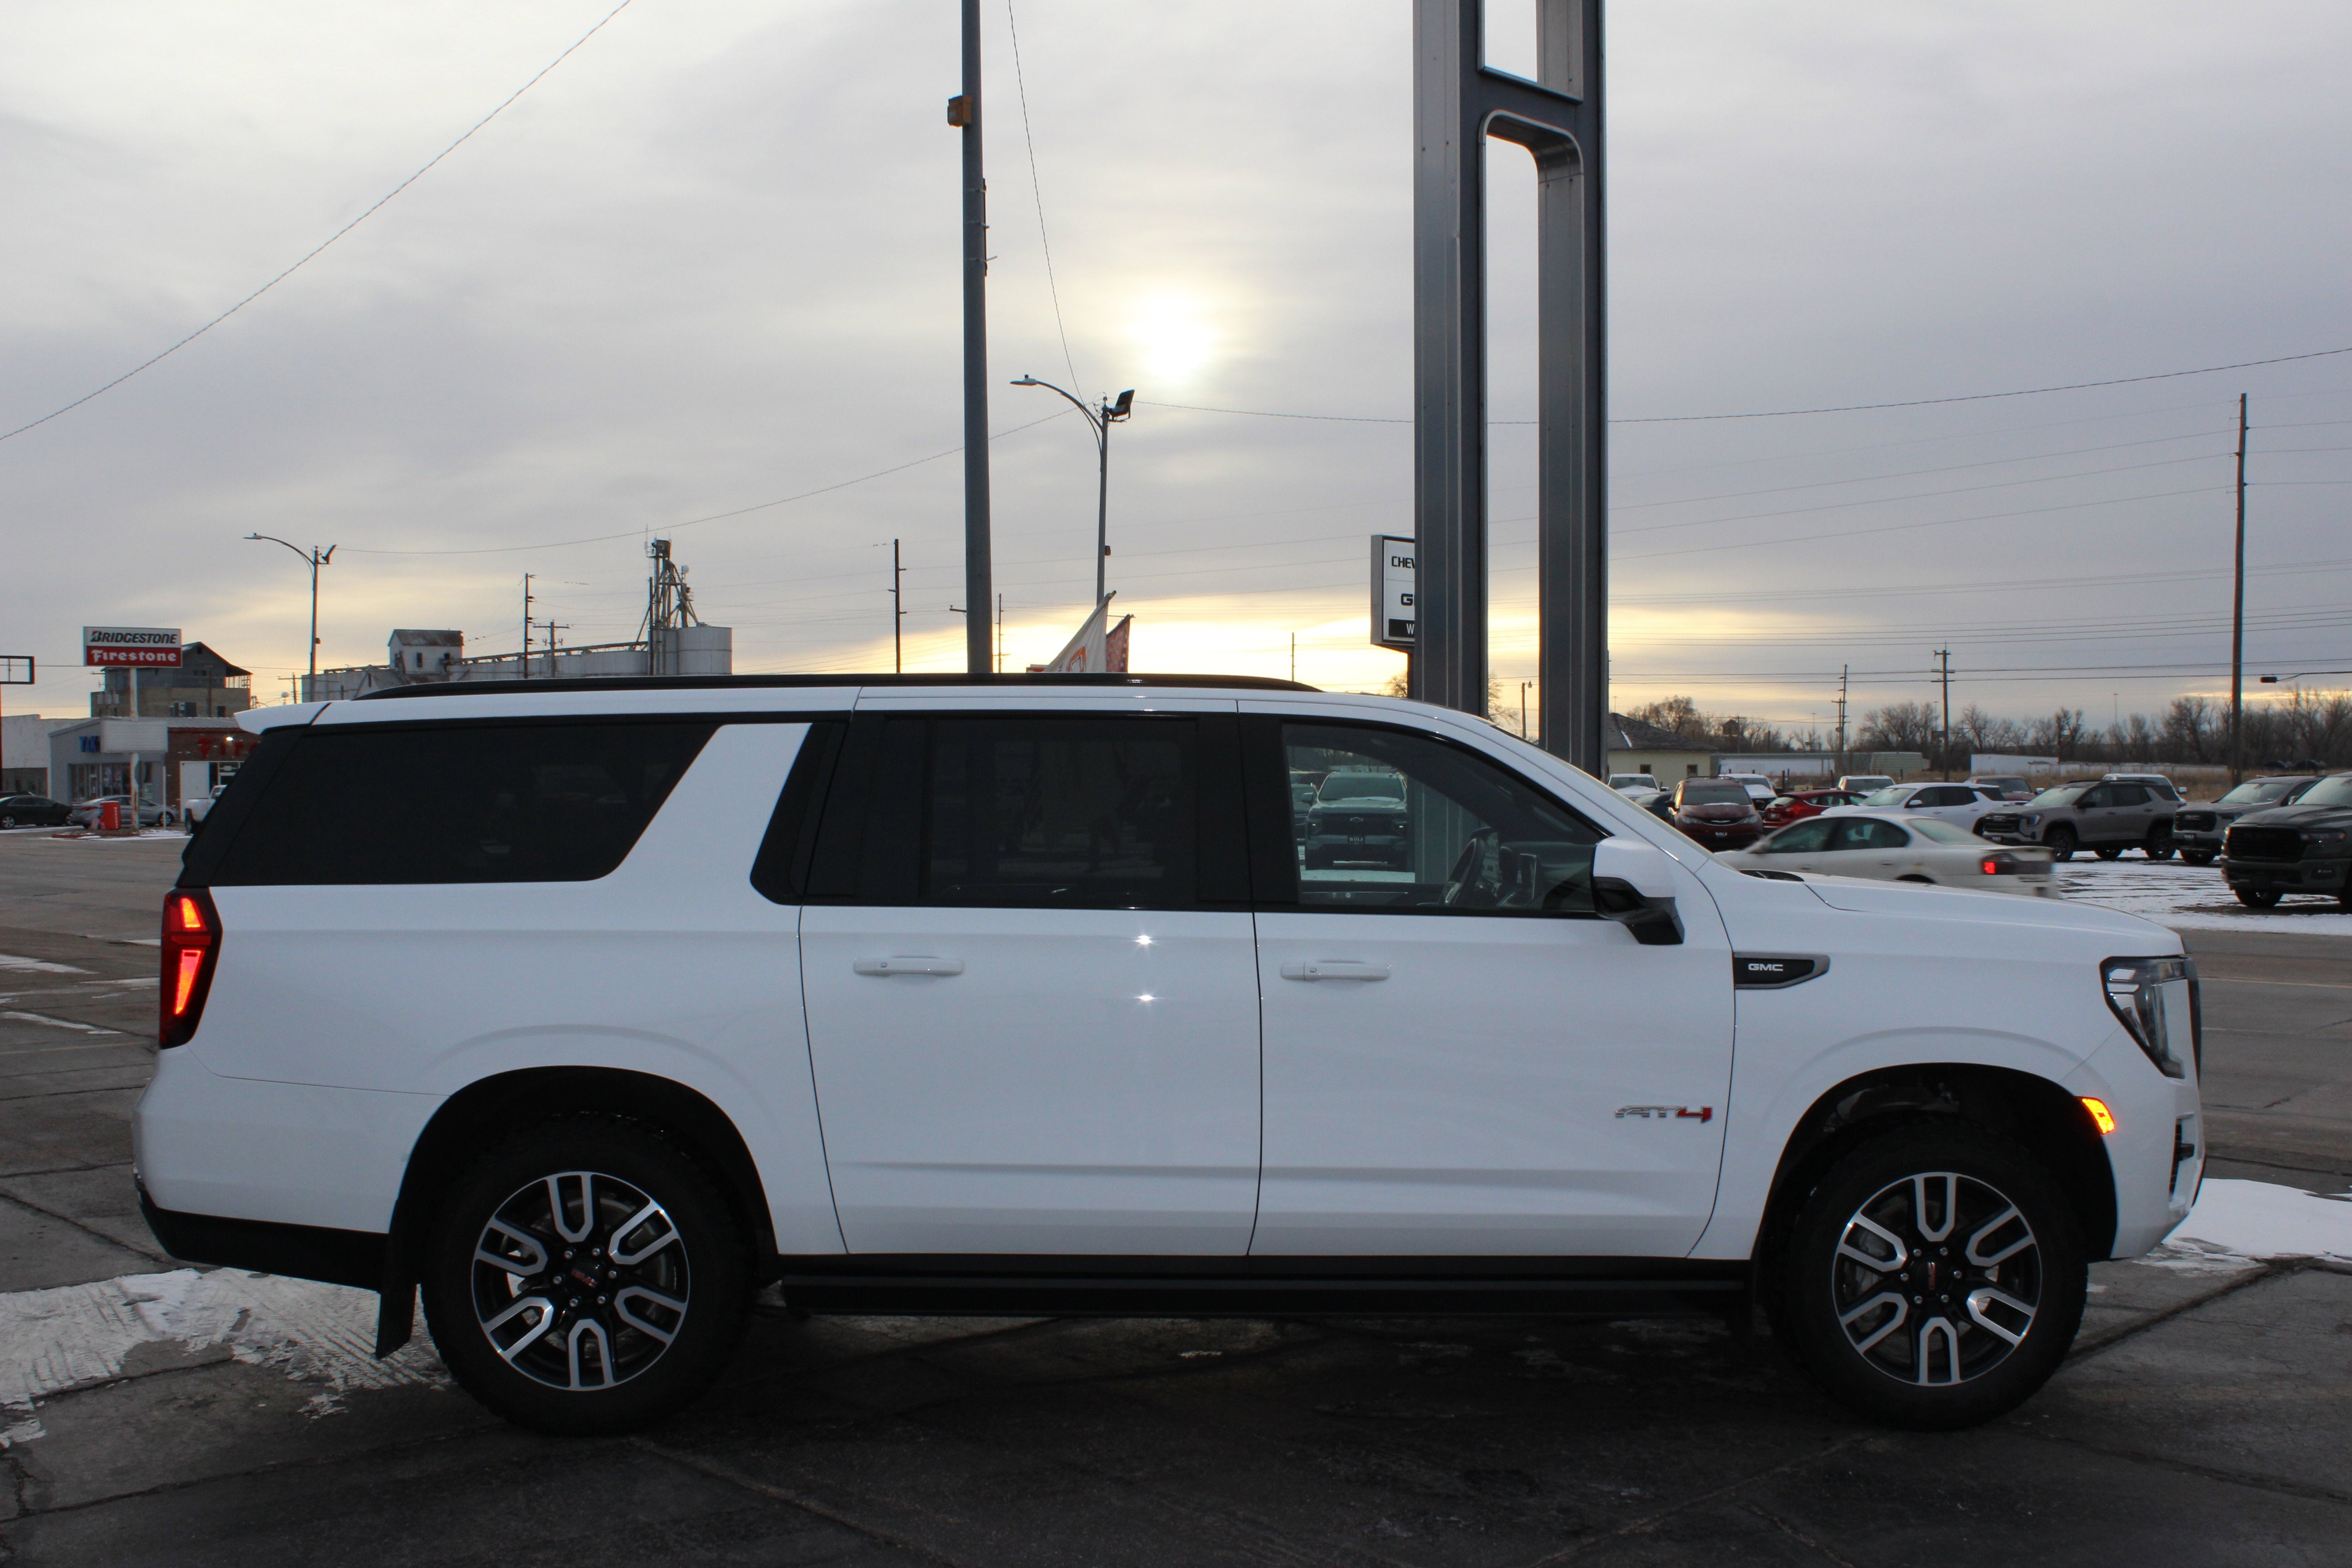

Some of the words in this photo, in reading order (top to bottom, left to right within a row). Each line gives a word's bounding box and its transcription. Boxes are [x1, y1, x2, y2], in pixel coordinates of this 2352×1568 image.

[1401, 593, 1415, 606] G
[91, 631, 177, 644] BRIDGESTONE
[92, 650, 176, 663] Firestone
[1616, 1105, 1712, 1123] AT4
